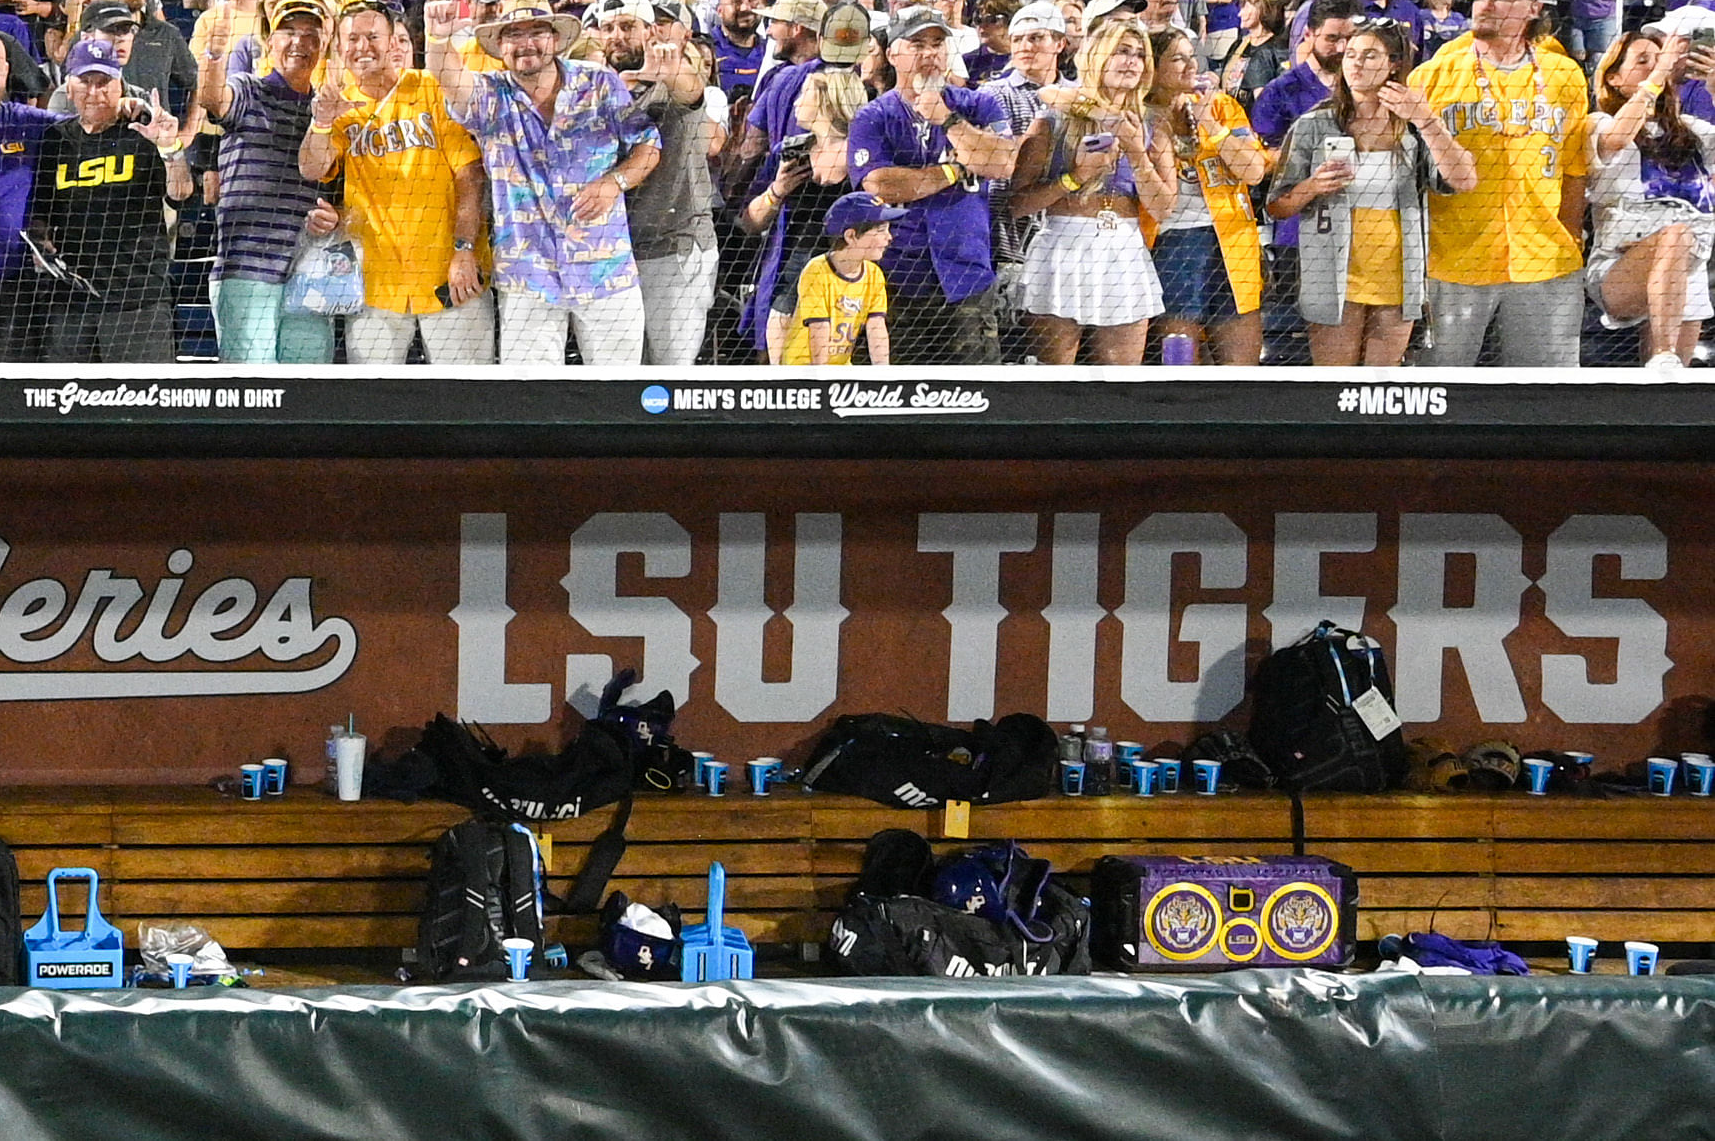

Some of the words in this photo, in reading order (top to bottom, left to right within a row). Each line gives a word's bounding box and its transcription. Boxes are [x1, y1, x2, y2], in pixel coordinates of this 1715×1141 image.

[1441, 99, 1567, 143] TIGERS
[0, 142, 25, 154] LSU
[1540, 145, 1558, 179] 3
[56, 154, 135, 190] LSU
[24, 388, 57, 407] THE
[57, 382, 160, 414] Greatest
[159, 388, 212, 407] SHOW
[215, 388, 240, 407] ON
[244, 388, 285, 407] DIRT
[674, 388, 735, 409] MEN'S
[740, 388, 822, 409] COLLEGE
[828, 383, 904, 408] World
[910, 383, 989, 410] Series
[1338, 387, 1448, 415] #MCWS
[449, 512, 850, 723] LSU
[915, 512, 1675, 723] TIGERS
[1228, 935, 1255, 945] LSU
[39, 964, 111, 977] POWERADE
